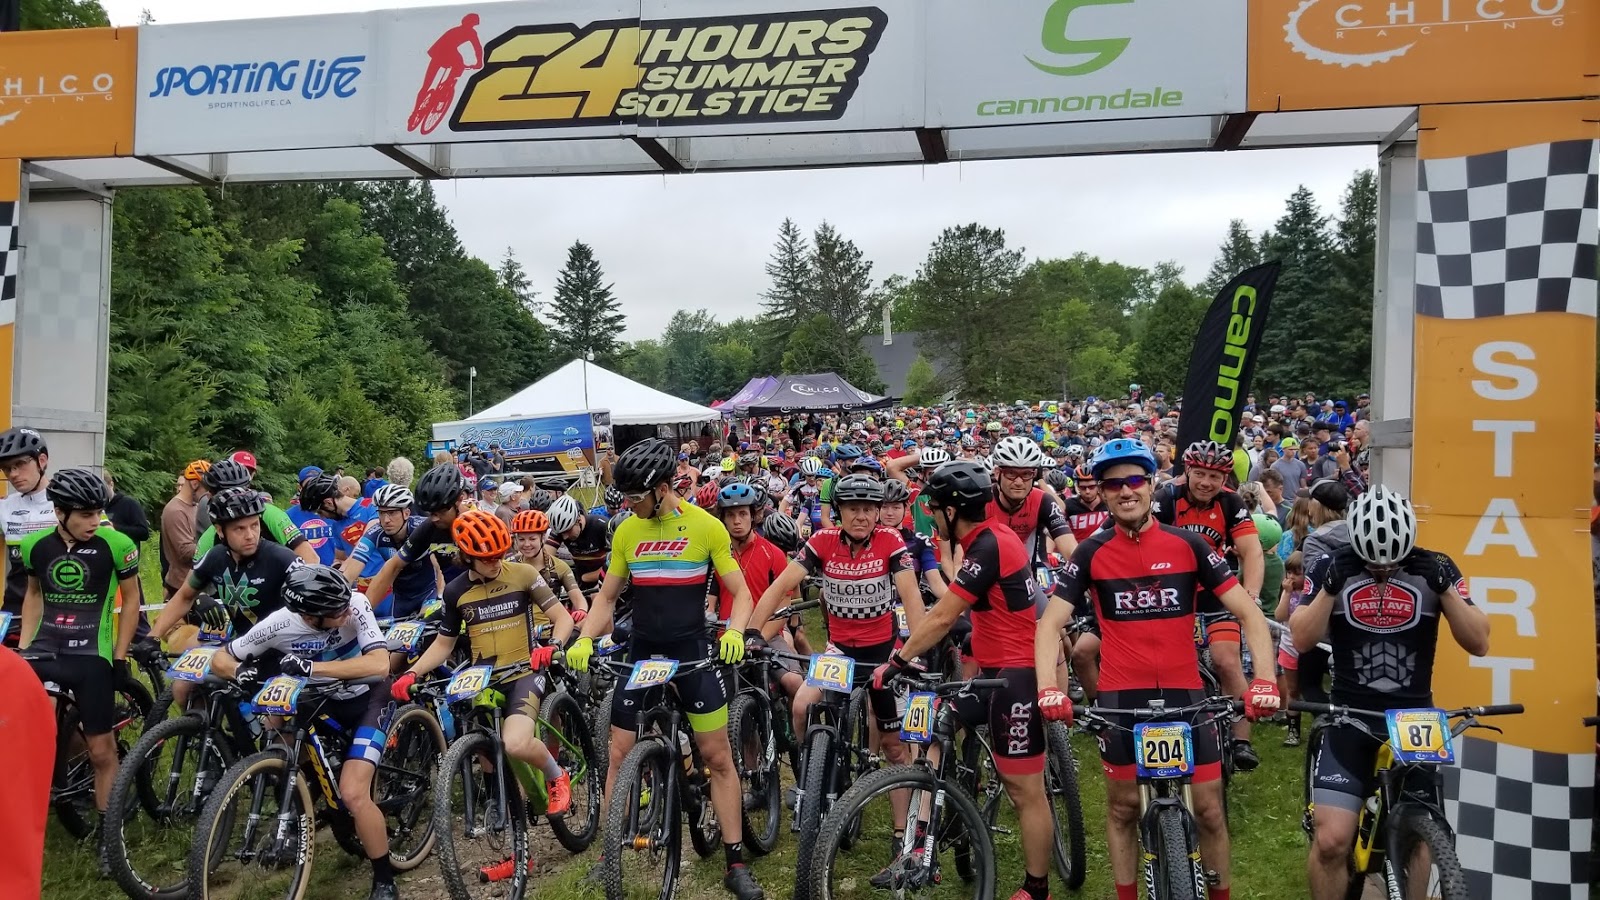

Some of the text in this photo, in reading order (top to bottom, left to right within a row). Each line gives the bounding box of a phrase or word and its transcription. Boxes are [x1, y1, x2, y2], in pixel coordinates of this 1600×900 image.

[1335, 0, 1565, 27] CHICO
[1335, 17, 1565, 40] RACING
[459, 16, 873, 123] 24 HOURS
[643, 57, 857, 92] SUMMER
[208, 99, 292, 110] SPORTINGLIFE.CA
[615, 86, 843, 118] SOLSTICE
[976, 86, 1183, 117] cannondale
[1209, 285, 1257, 444] canno
[1464, 341, 1539, 705] START
[826, 558, 884, 571] KALLISTO
[285, 588, 304, 603] KASK
[825, 581, 886, 596] PELOTON
[1114, 587, 1180, 610] R&R
[1387, 602, 1412, 612] AVE
[178, 655, 207, 670] 248
[823, 664, 840, 680] 72
[263, 685, 291, 702] 351
[454, 675, 482, 691] 327
[1251, 695, 1281, 708] FOX
[909, 707, 925, 728] 191
[1008, 702, 1033, 755] R&R
[1408, 725, 1432, 747] 87
[1146, 740, 1183, 763] 204
